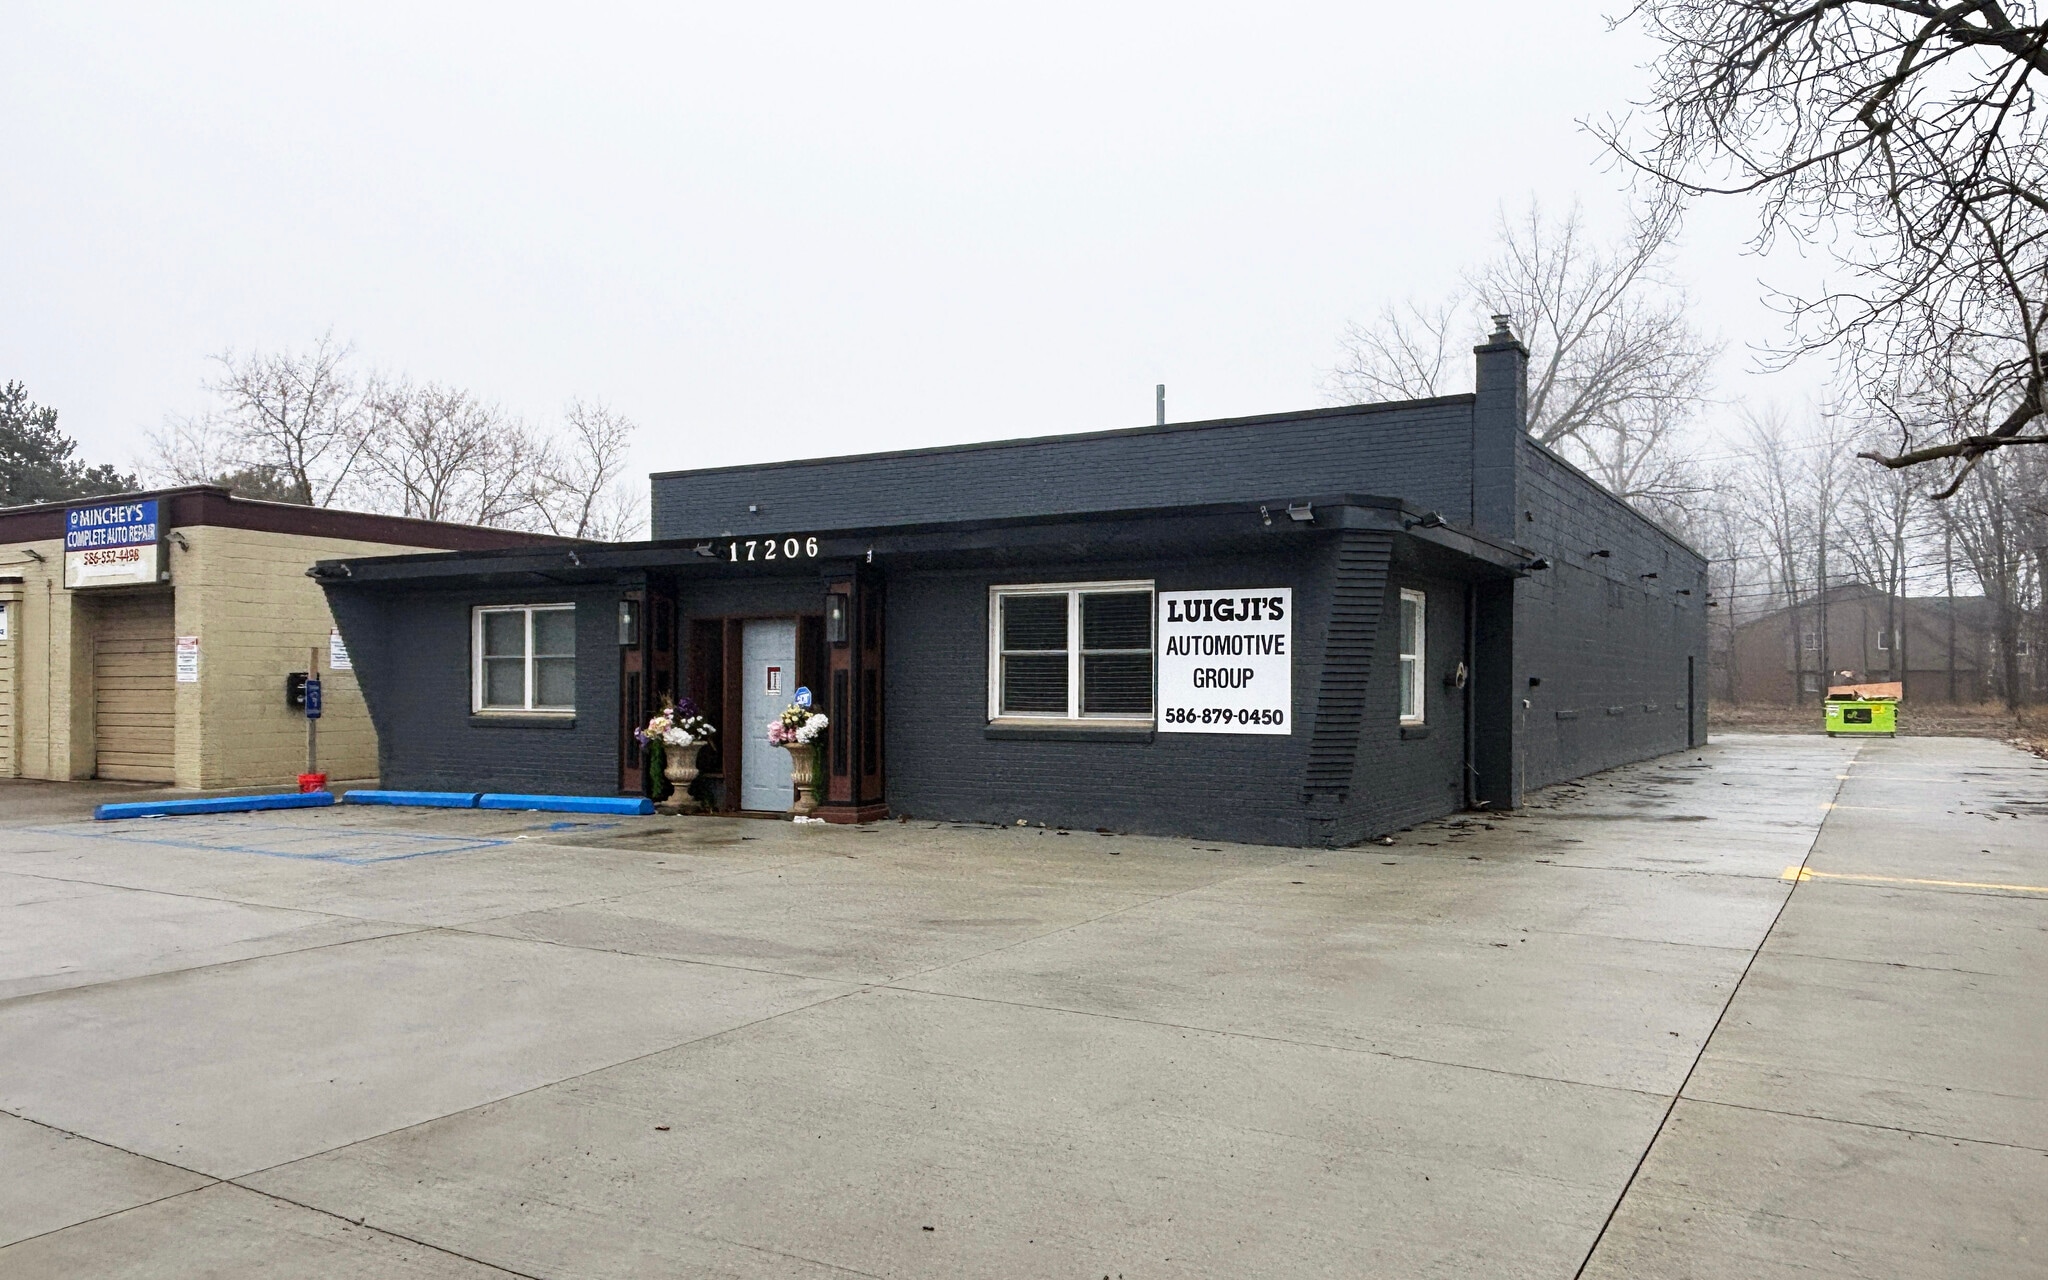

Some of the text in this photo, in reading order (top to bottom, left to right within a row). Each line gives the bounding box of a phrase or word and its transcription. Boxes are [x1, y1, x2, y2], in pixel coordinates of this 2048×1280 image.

[80, 504, 143, 526] MINCHEY'S
[67, 523, 156, 547] COMPLETE AUTO REPAIR
[729, 537, 818, 561] 17206
[1167, 597, 1284, 622] LUIGJI'S
[1166, 634, 1285, 656] AUTOMOTIVE
[1193, 668, 1254, 689] GROUP
[1165, 708, 1283, 725] 586-879-0450
